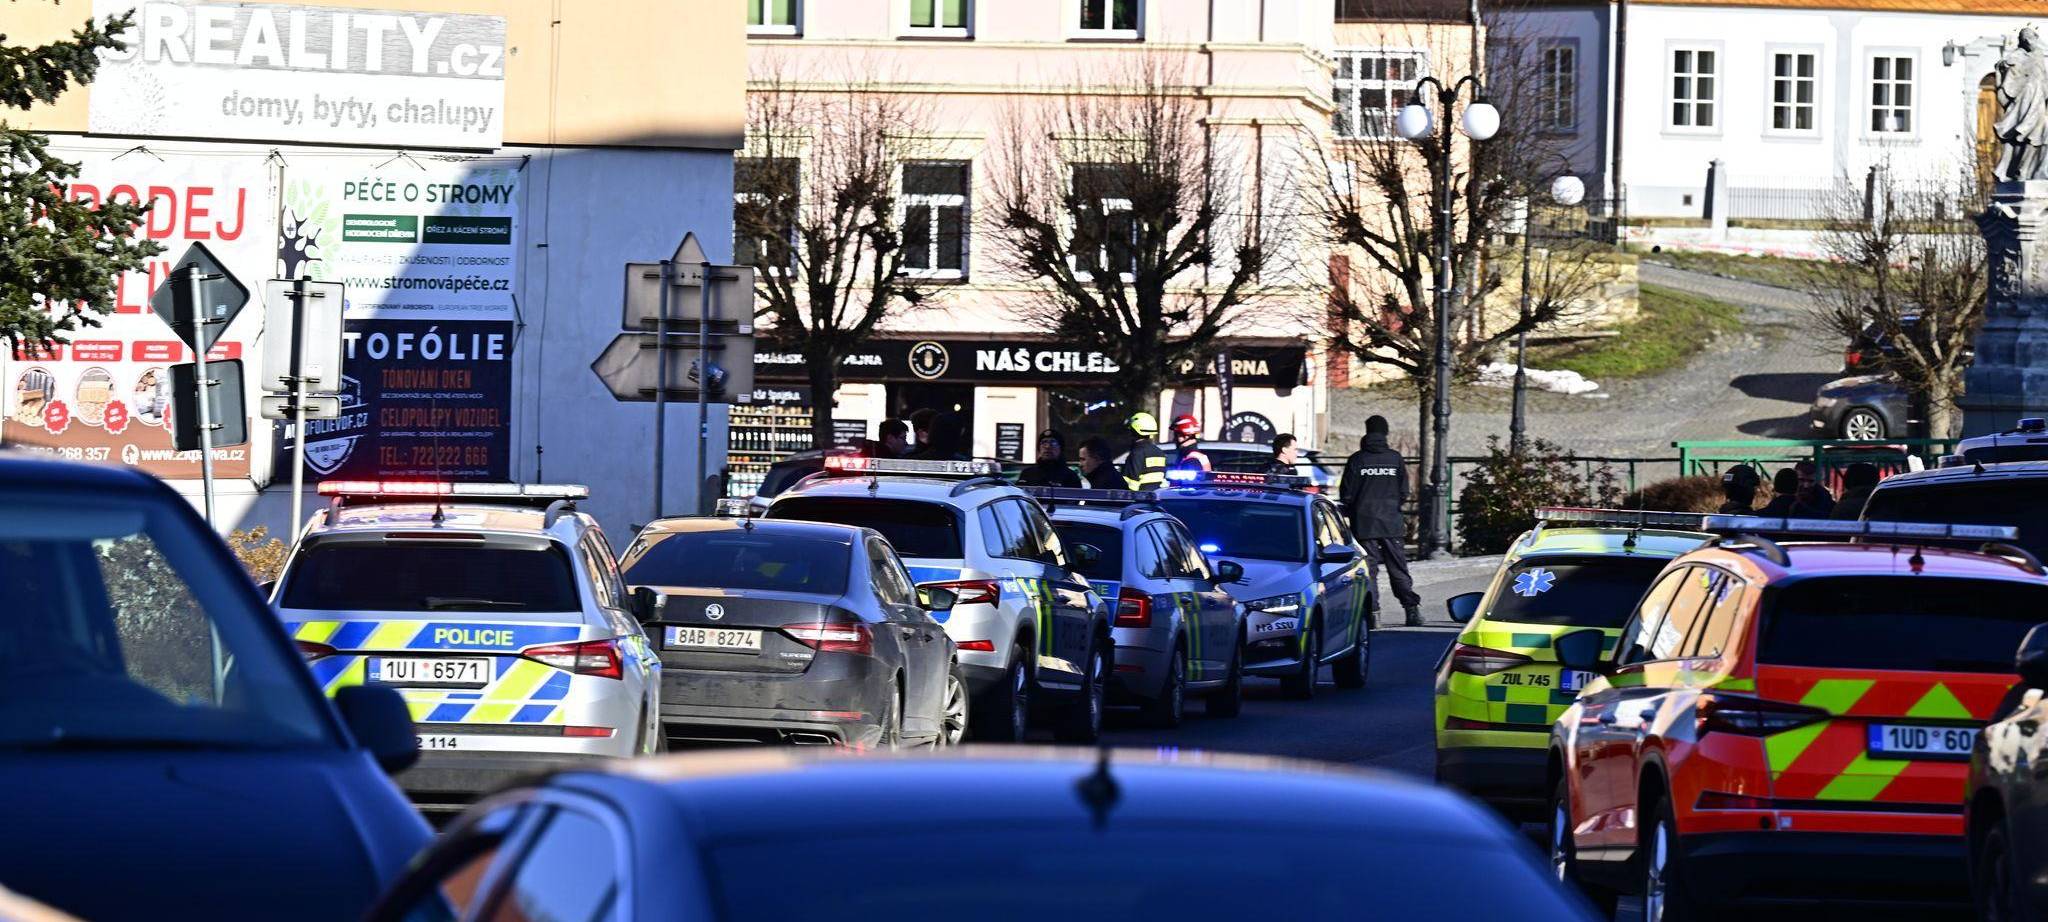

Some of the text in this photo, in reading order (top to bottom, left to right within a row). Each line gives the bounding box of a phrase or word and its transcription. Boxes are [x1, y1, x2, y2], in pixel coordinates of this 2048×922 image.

[221, 89, 494, 133] domy, byty, chalupy
[344, 177, 514, 204] PÉČE O STROMY
[457, 256, 510, 266] ODBORNOST
[340, 274, 509, 294] www.stromovápéče.cz
[342, 326, 505, 360] TOFÓLIE
[976, 347, 1031, 372] NÁŠ
[84, 447, 112, 461] 357
[412, 446, 434, 466] 722
[438, 446, 461, 466] 222
[434, 628, 514, 646] POLICIE
[679, 629, 754, 647] 8AB 8274
[434, 662, 478, 680] 6571
[1501, 673, 1550, 687] ZUL 745
[429, 736, 457, 748] 114
[1889, 728, 1972, 751] 1UD 60
